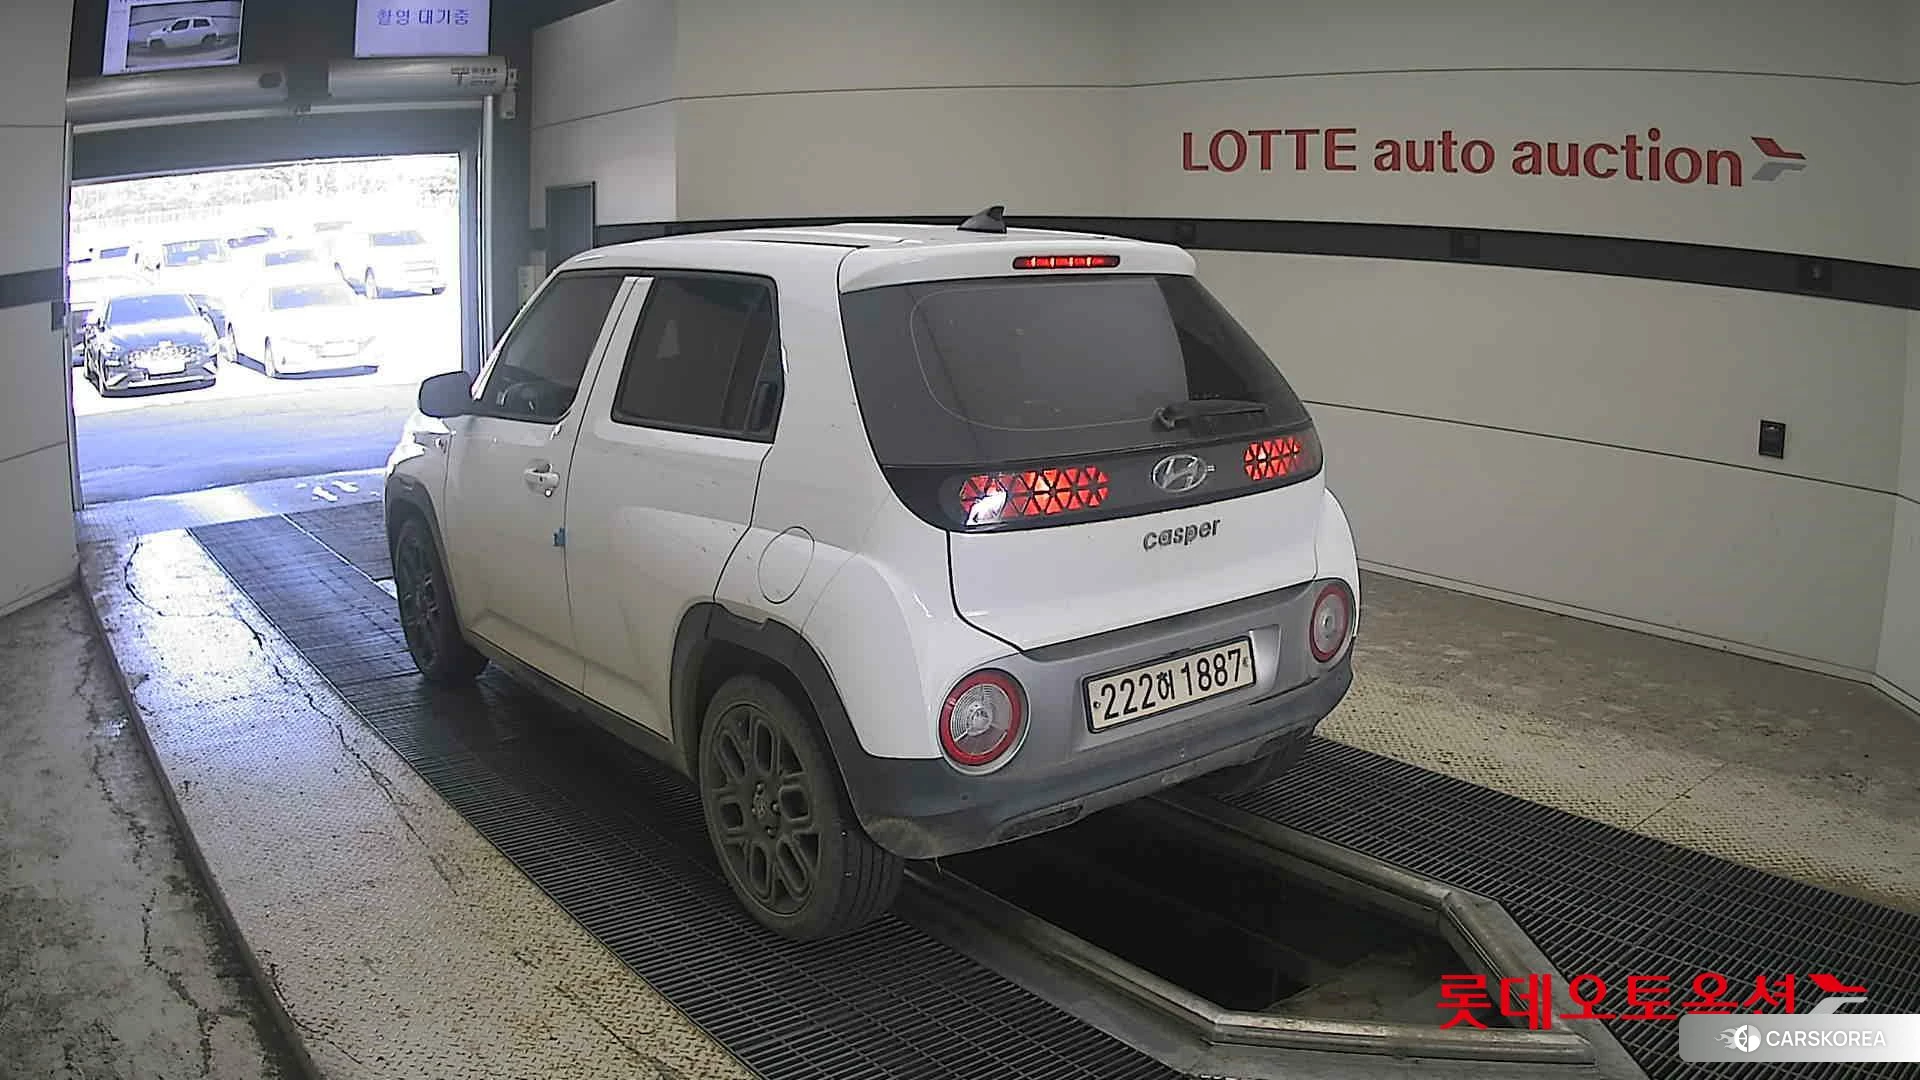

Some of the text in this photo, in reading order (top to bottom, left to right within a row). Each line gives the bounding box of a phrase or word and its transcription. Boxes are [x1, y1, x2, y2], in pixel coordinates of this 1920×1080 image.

[418, 8, 471, 26] 대기중
[1182, 128, 1742, 187] LOTTE auto auction
[1142, 519, 1221, 552] casper
